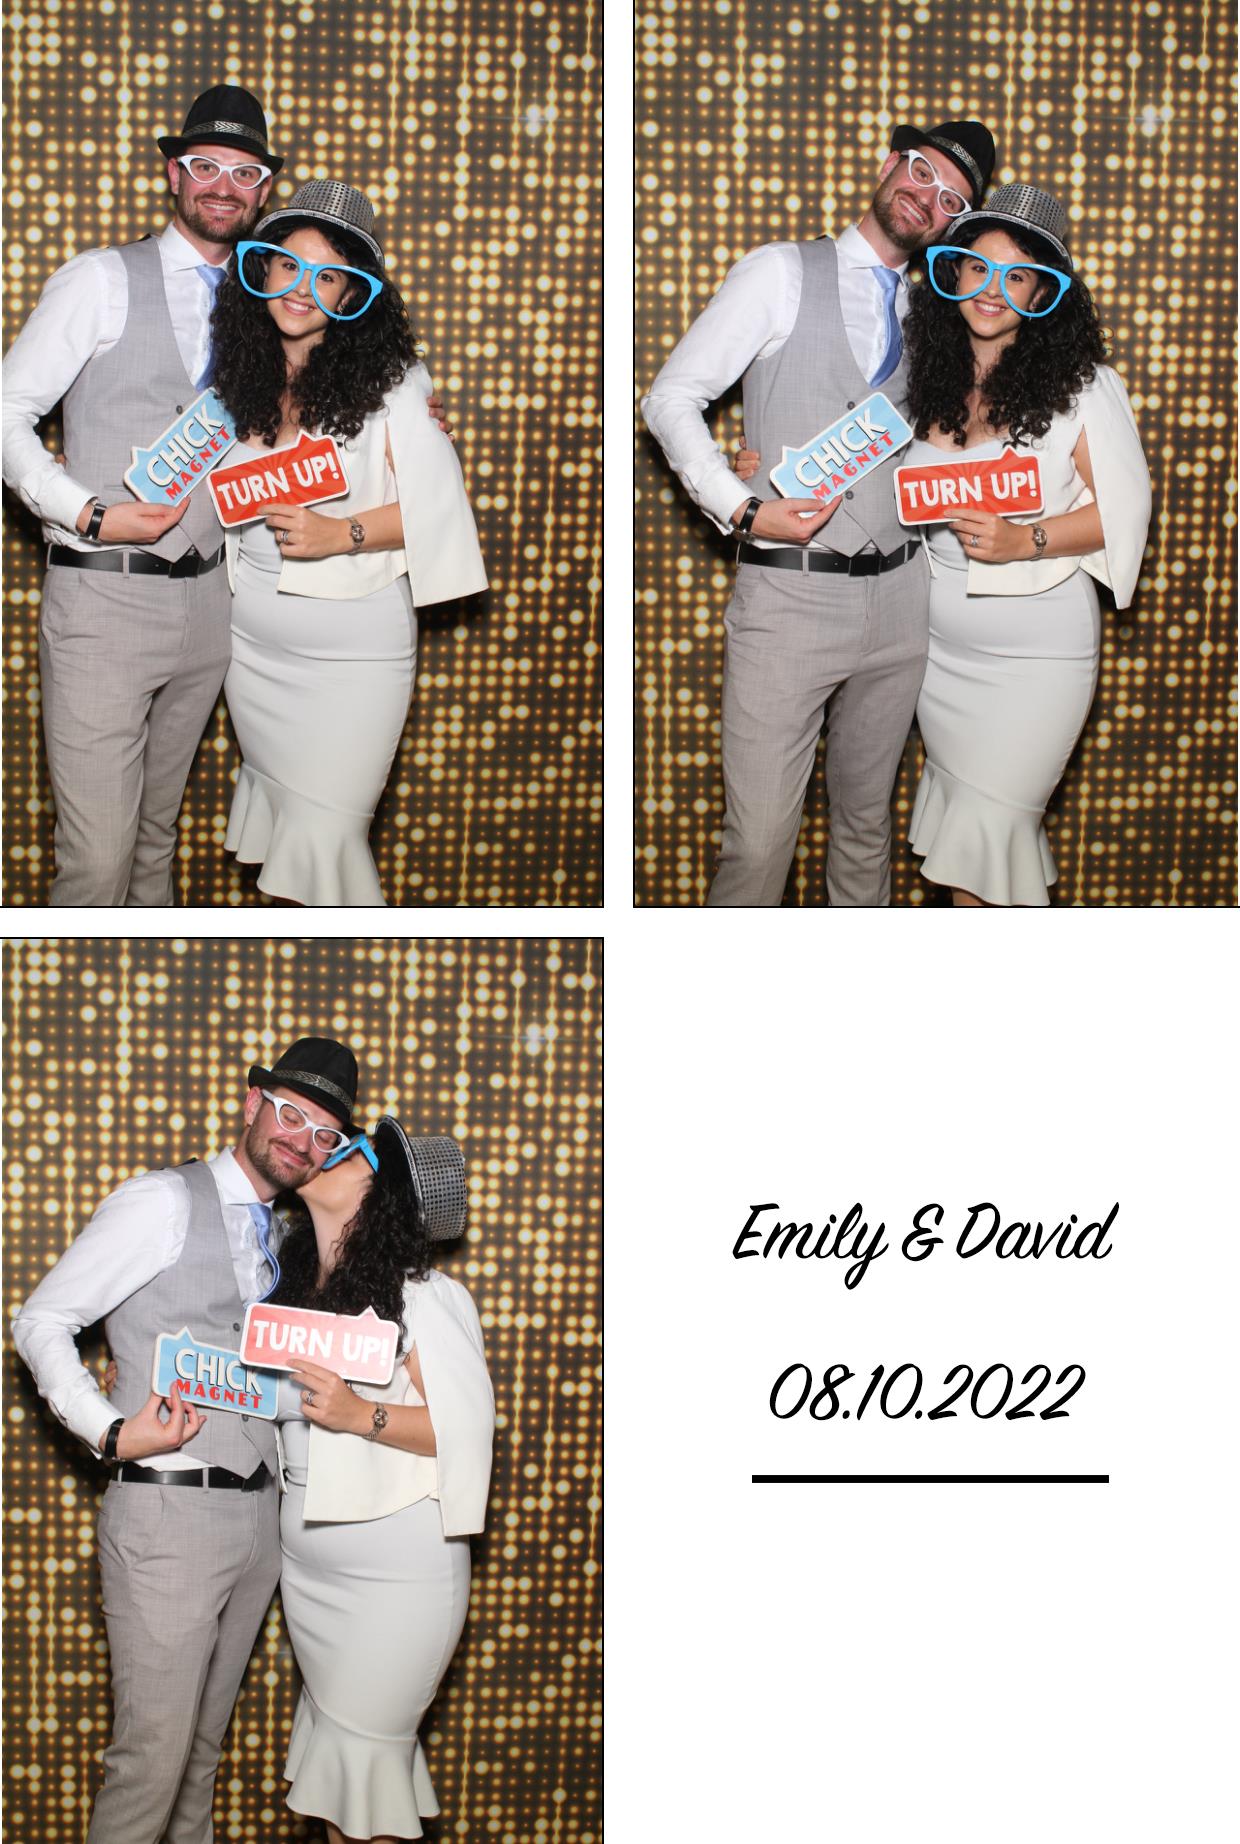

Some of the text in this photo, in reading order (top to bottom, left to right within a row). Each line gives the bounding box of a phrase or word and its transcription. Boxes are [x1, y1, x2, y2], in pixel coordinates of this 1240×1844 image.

[146, 402, 224, 488] CHICK
[165, 426, 231, 500] MAGNET
[795, 407, 889, 488] CHICK
[812, 431, 895, 501] MAGNET
[216, 451, 339, 511] TURN UP!
[903, 470, 1038, 509] TURN UP!
[174, 1348, 263, 1396] CHICK
[253, 1319, 390, 1367] TURN UP!
[176, 1378, 263, 1409] MAGNET
